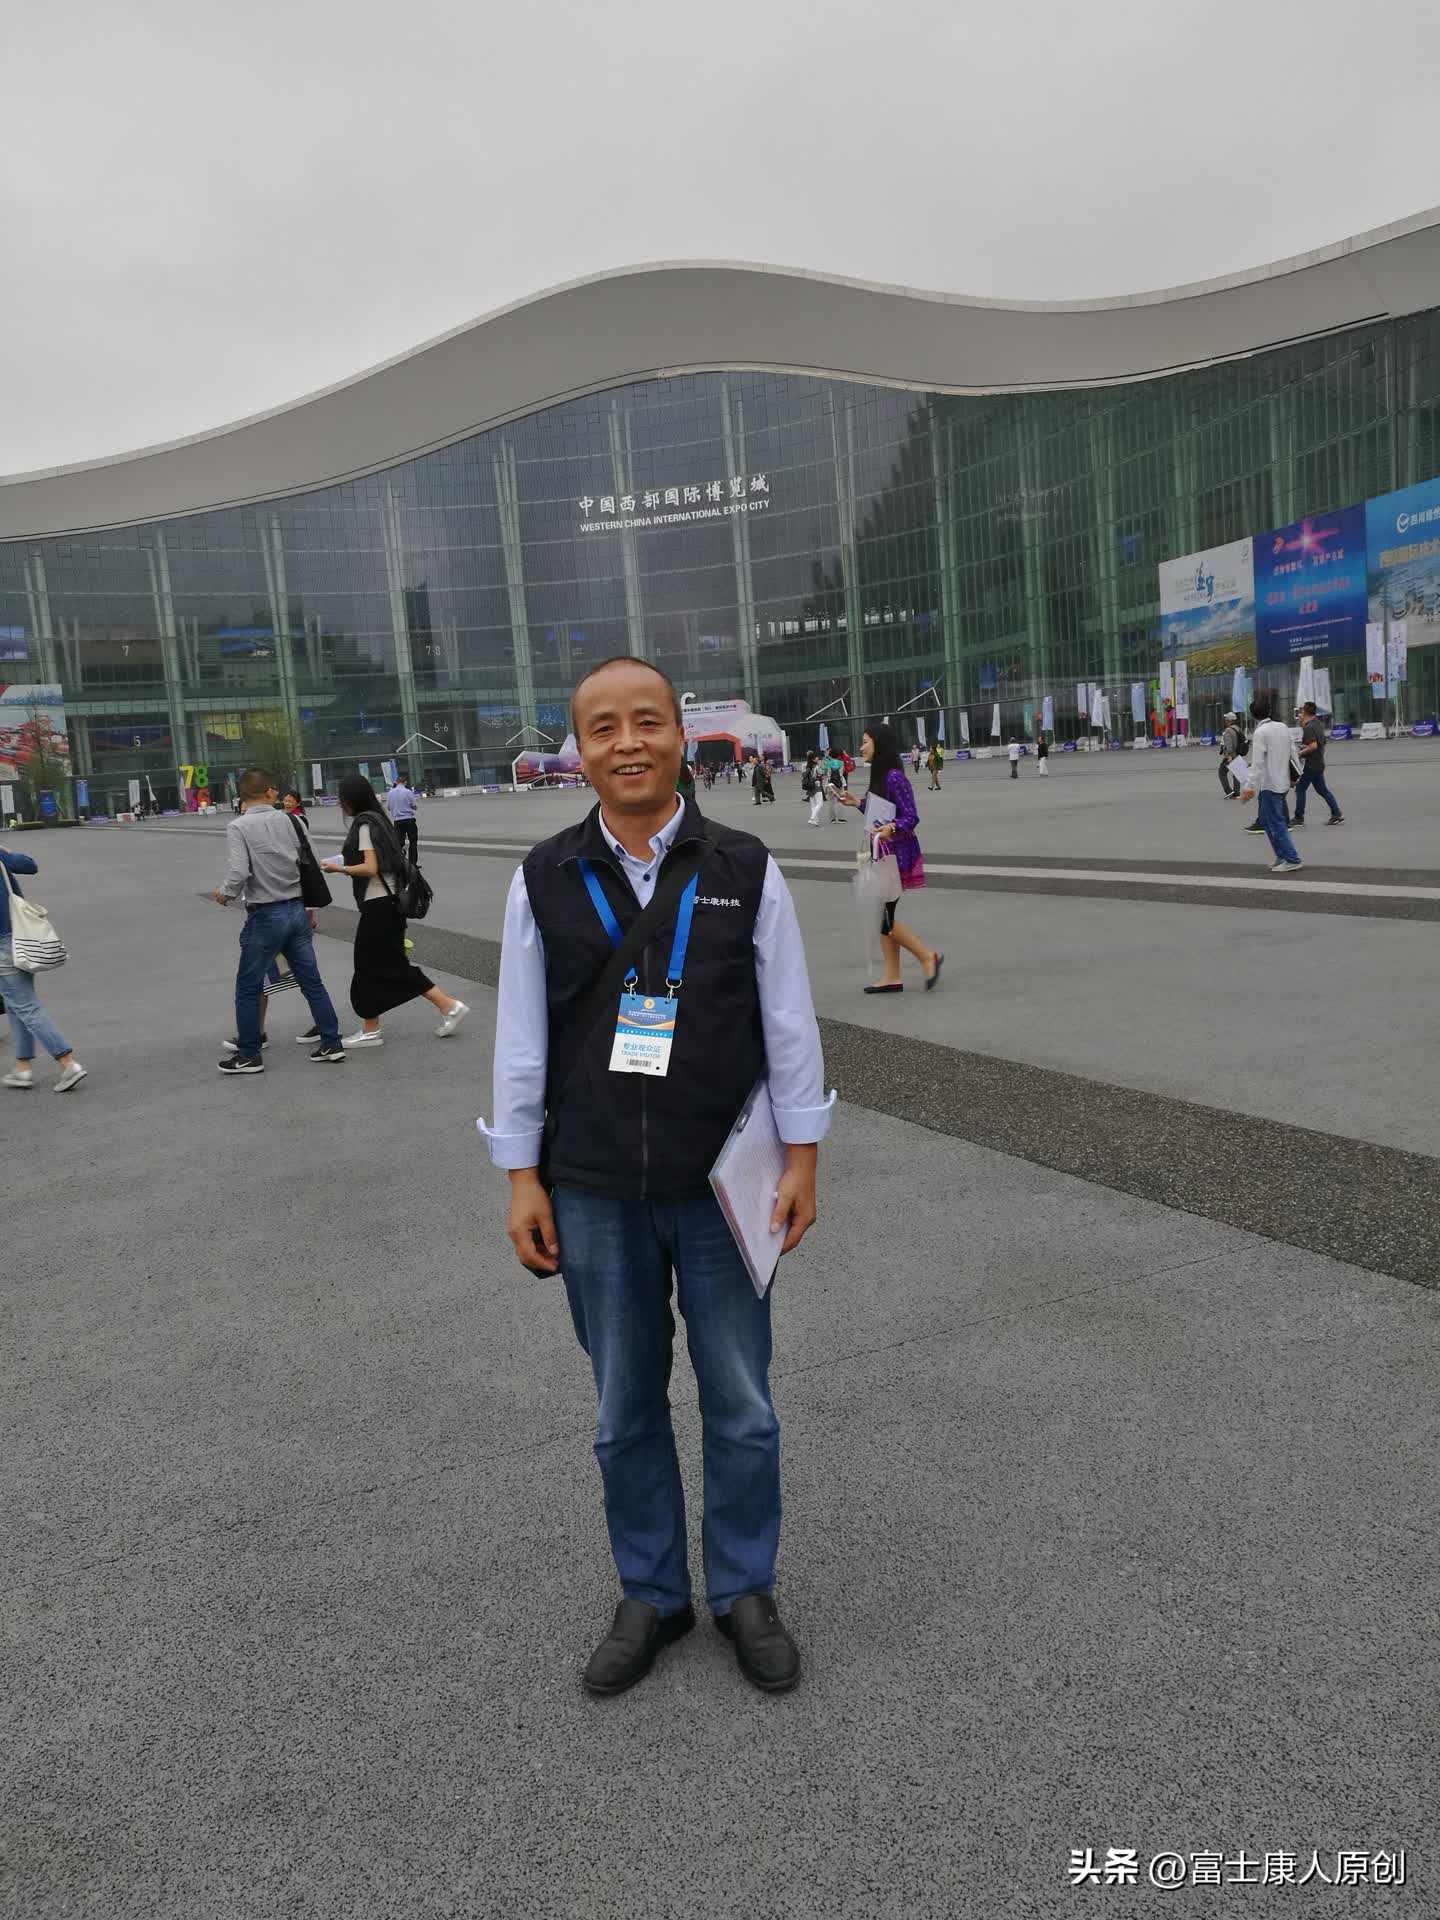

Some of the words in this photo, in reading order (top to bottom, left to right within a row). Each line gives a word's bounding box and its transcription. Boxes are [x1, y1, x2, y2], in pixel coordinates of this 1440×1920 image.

[578, 472, 770, 518] 中国西部国际博览城
[580, 520, 623, 532] WESTERN
[624, 517, 652, 528] CHINA
[653, 508, 722, 525] INTERNATIONAL
[723, 503, 748, 515] EXPO
[749, 498, 770, 511] CITY
